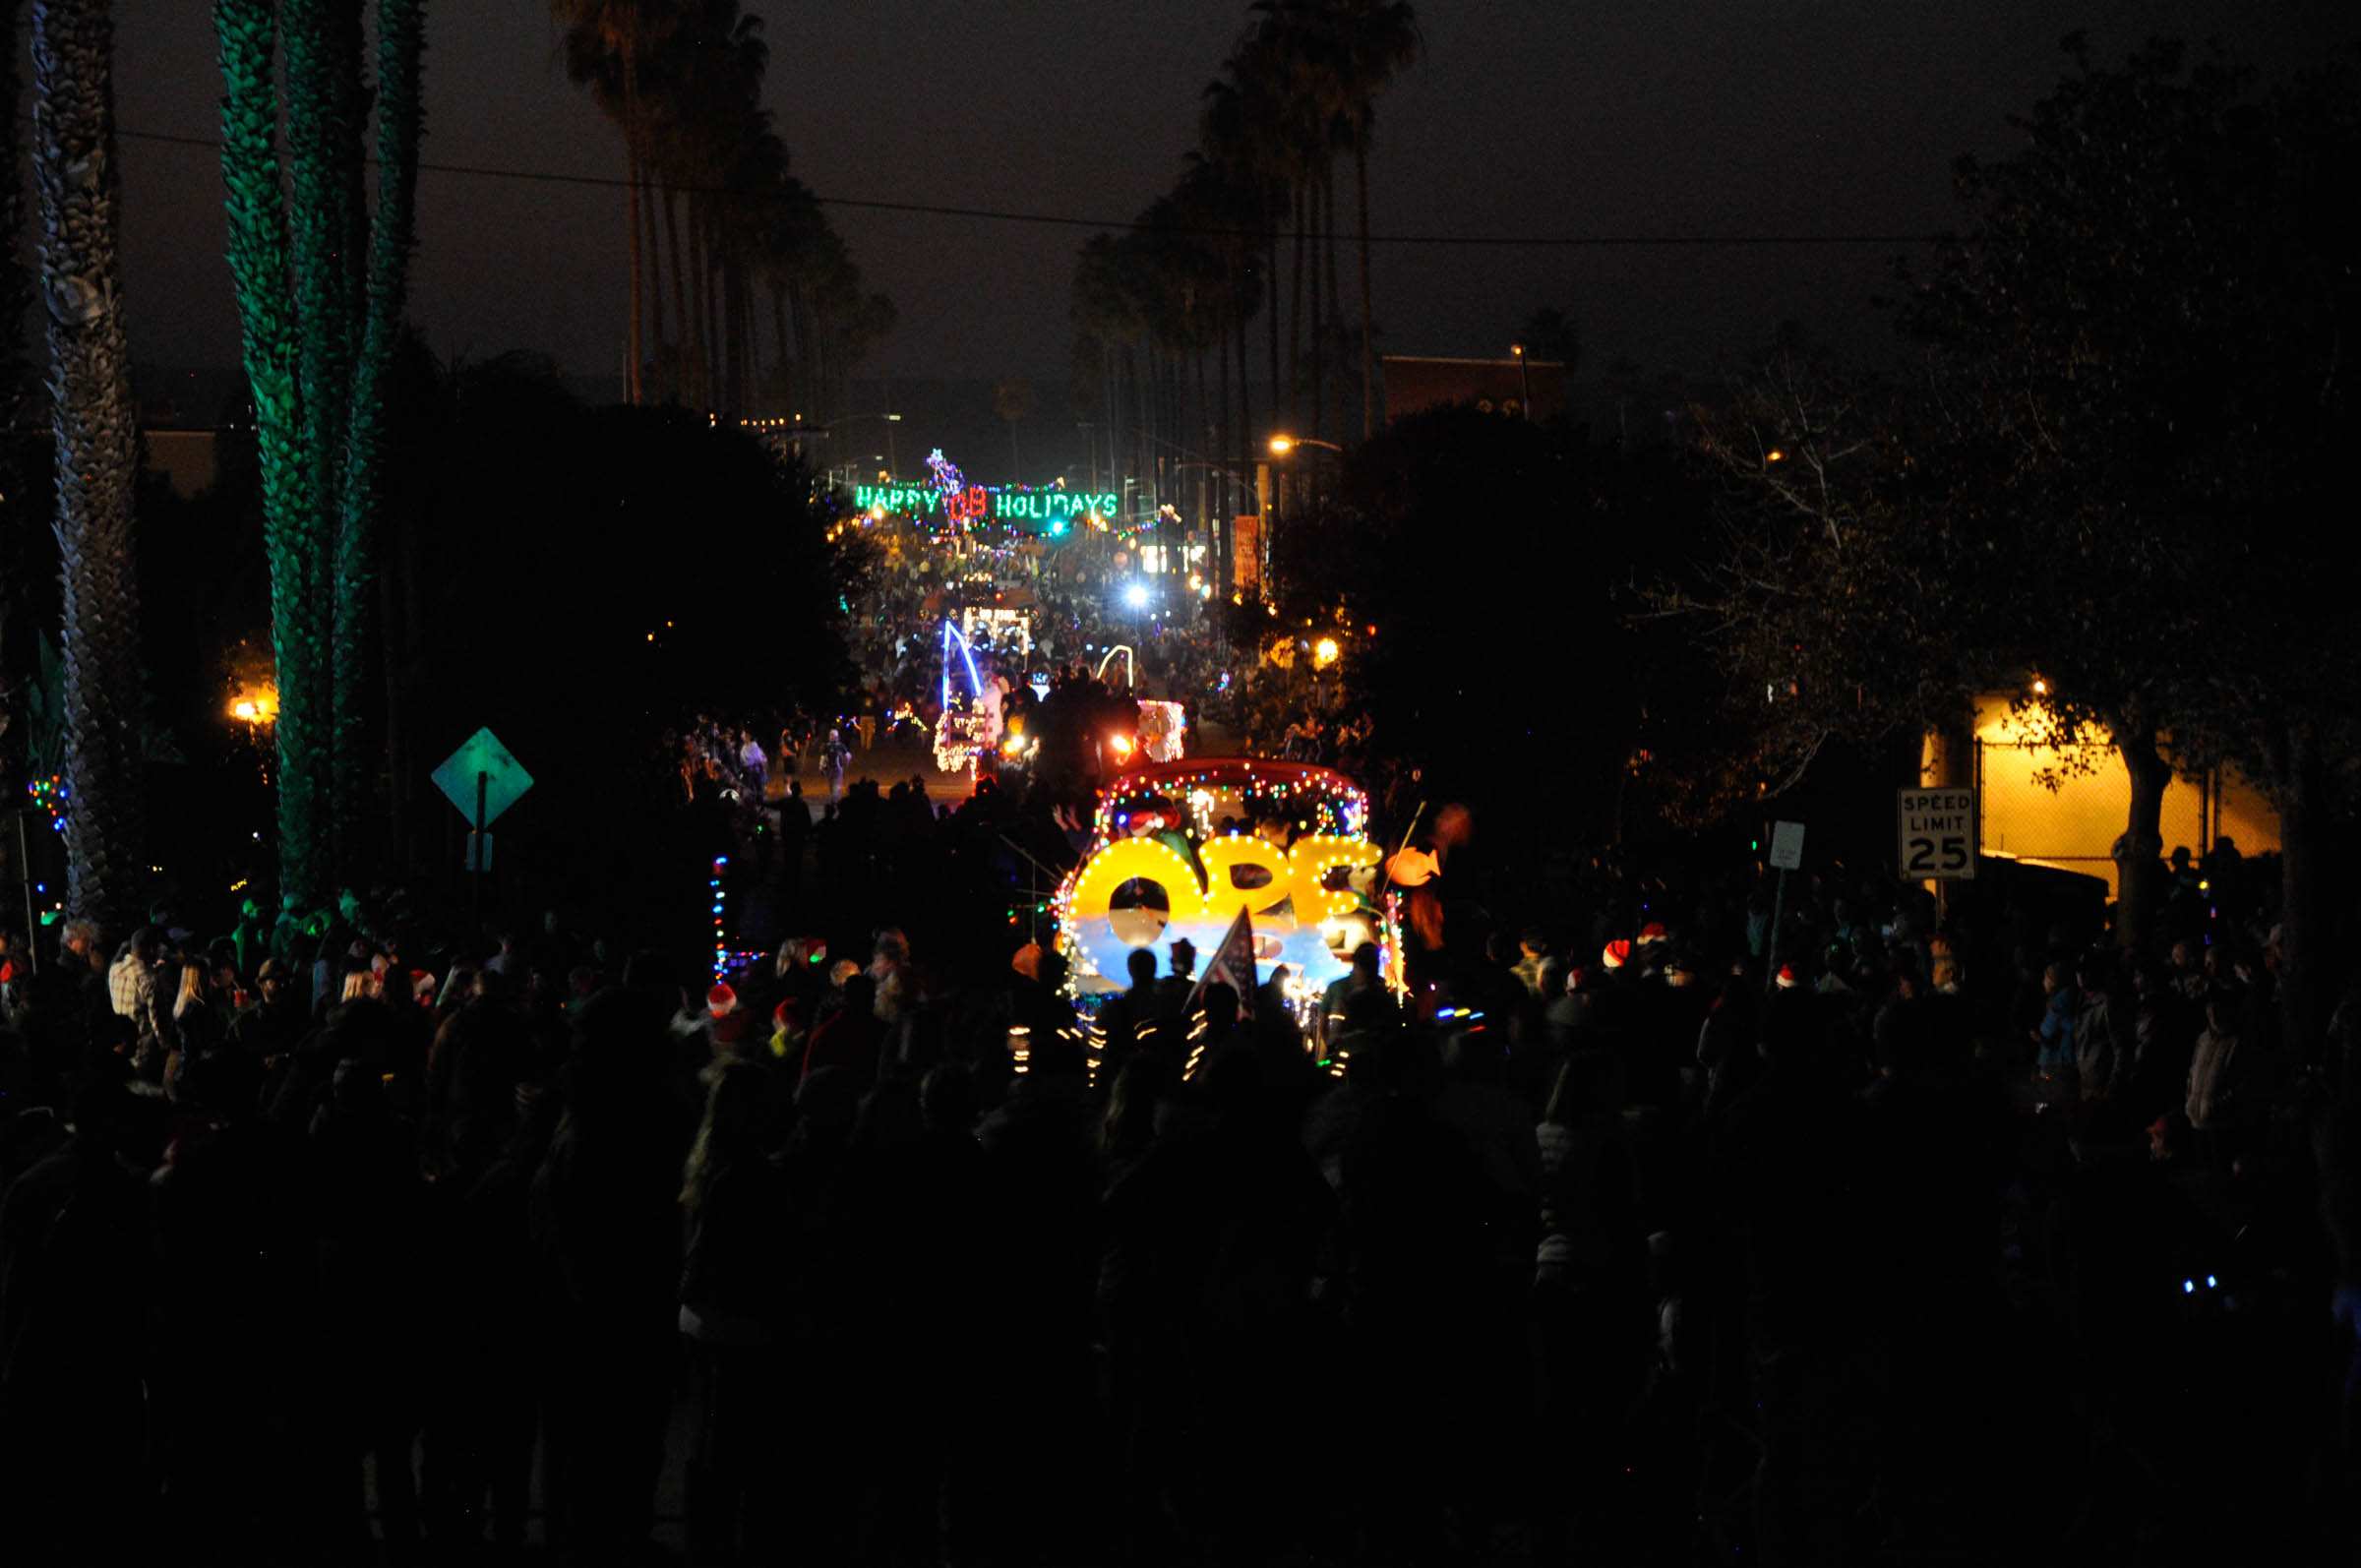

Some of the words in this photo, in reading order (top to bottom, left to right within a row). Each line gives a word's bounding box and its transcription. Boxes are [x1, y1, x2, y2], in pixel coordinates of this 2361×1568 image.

[855, 485, 939, 513] HAPPY
[949, 486, 988, 520] OB
[1905, 795, 1969, 811] SPEED
[1910, 816, 1965, 831] LIMIT
[1909, 837, 1968, 870] 25
